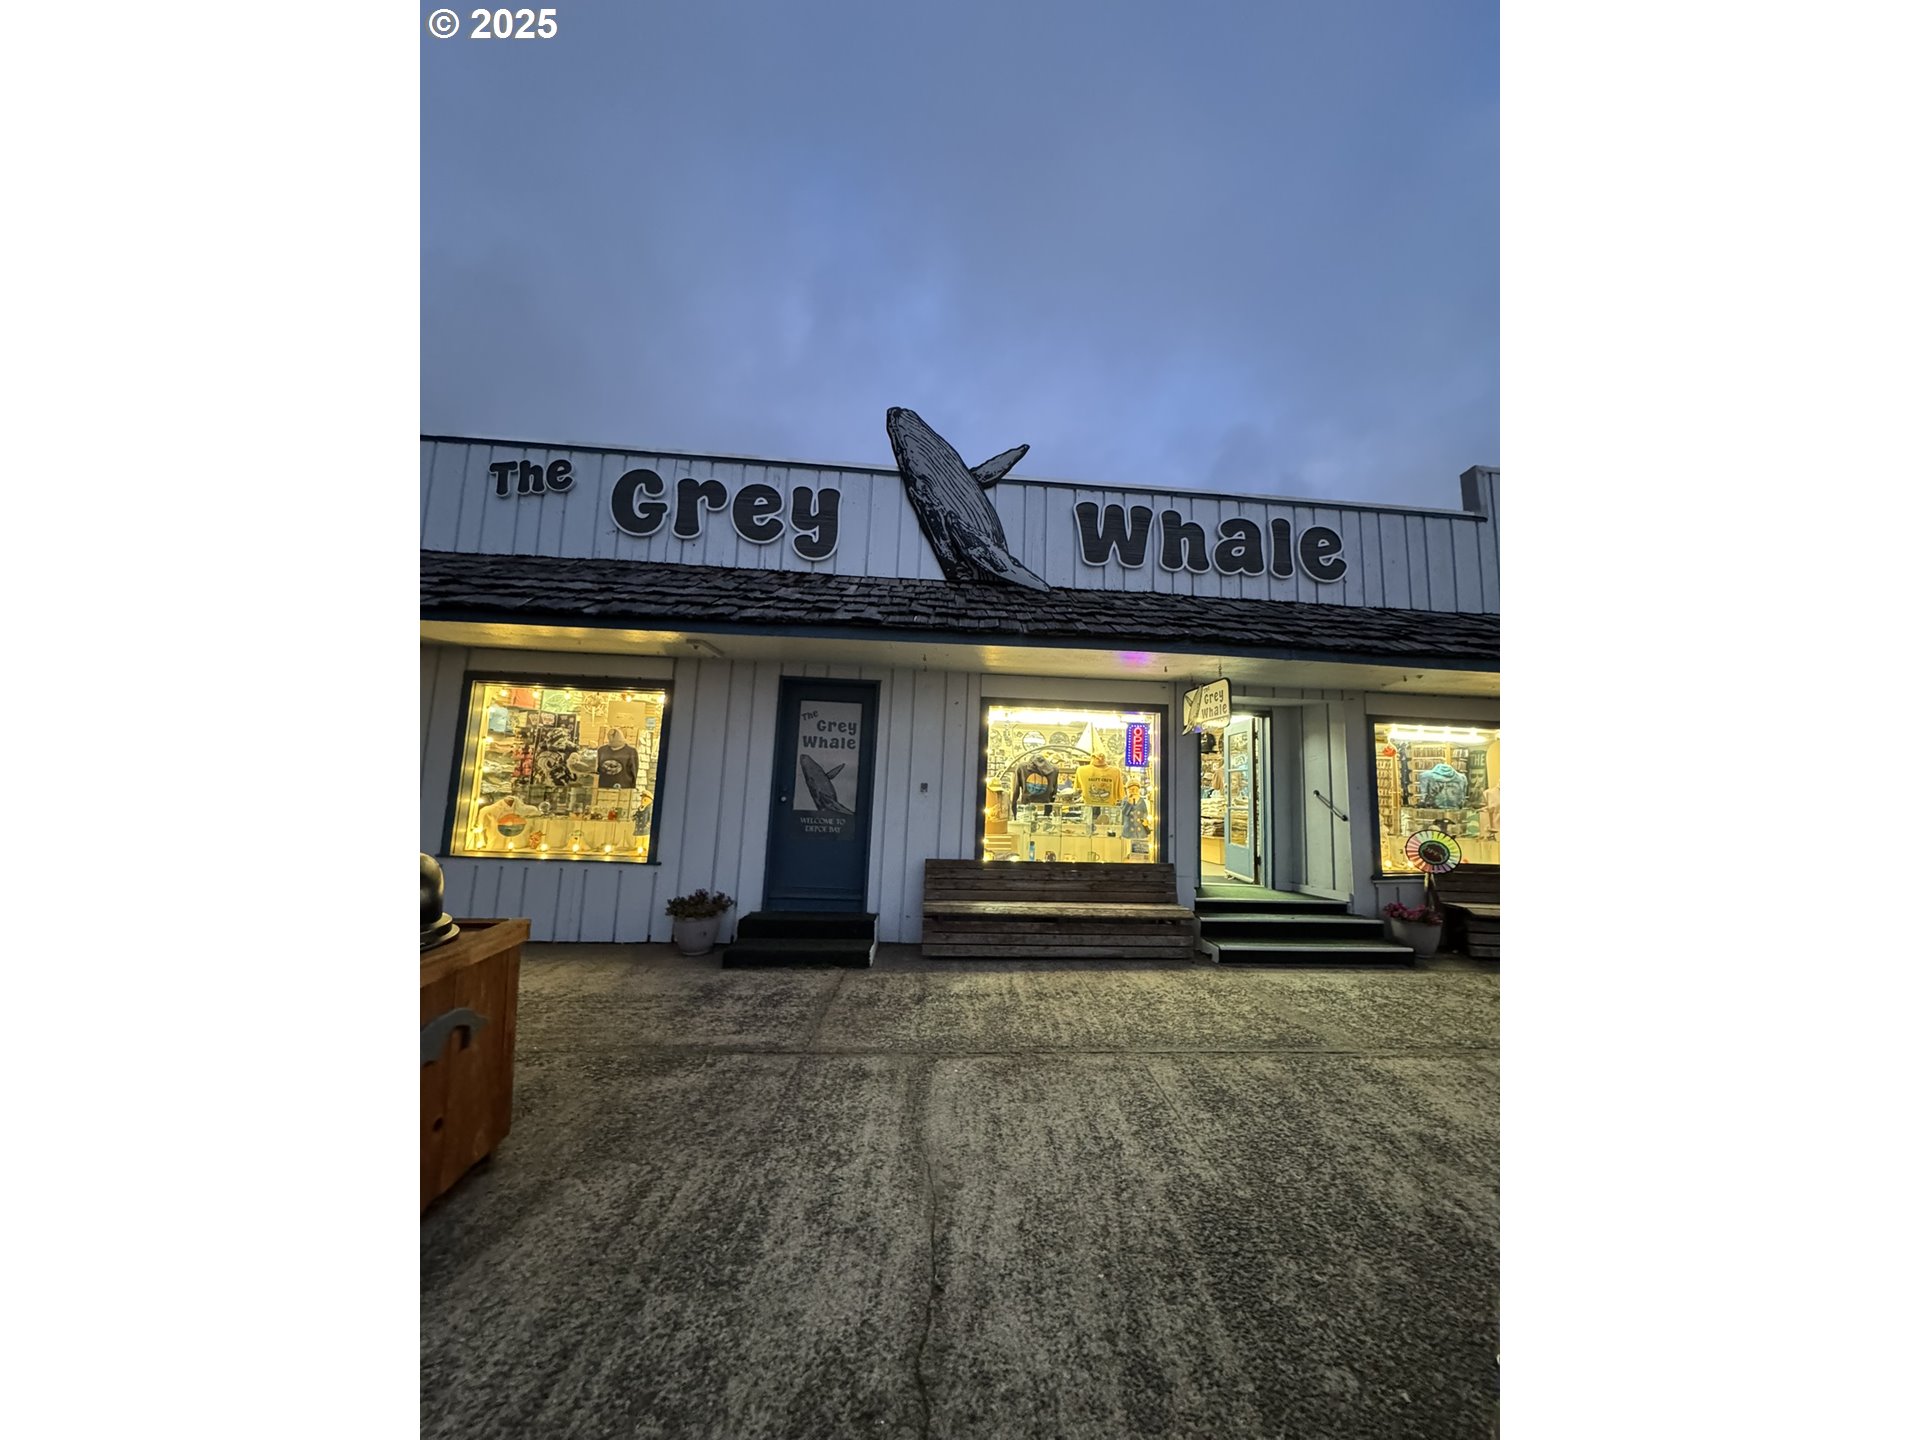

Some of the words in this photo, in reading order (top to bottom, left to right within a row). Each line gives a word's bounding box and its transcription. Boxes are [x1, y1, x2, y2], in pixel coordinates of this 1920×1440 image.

[489, 459, 575, 496] The
[611, 469, 841, 561] Grey
[1074, 502, 1347, 583] Whale
[1204, 690, 1224, 704] Grey
[801, 710, 819, 720] The
[1201, 703, 1228, 719] Whale
[816, 720, 857, 735] Grey
[802, 735, 857, 749] Whale
[1132, 727, 1143, 764] OPEN
[800, 816, 834, 826] WELCOME
[836, 817, 846, 826] TO
